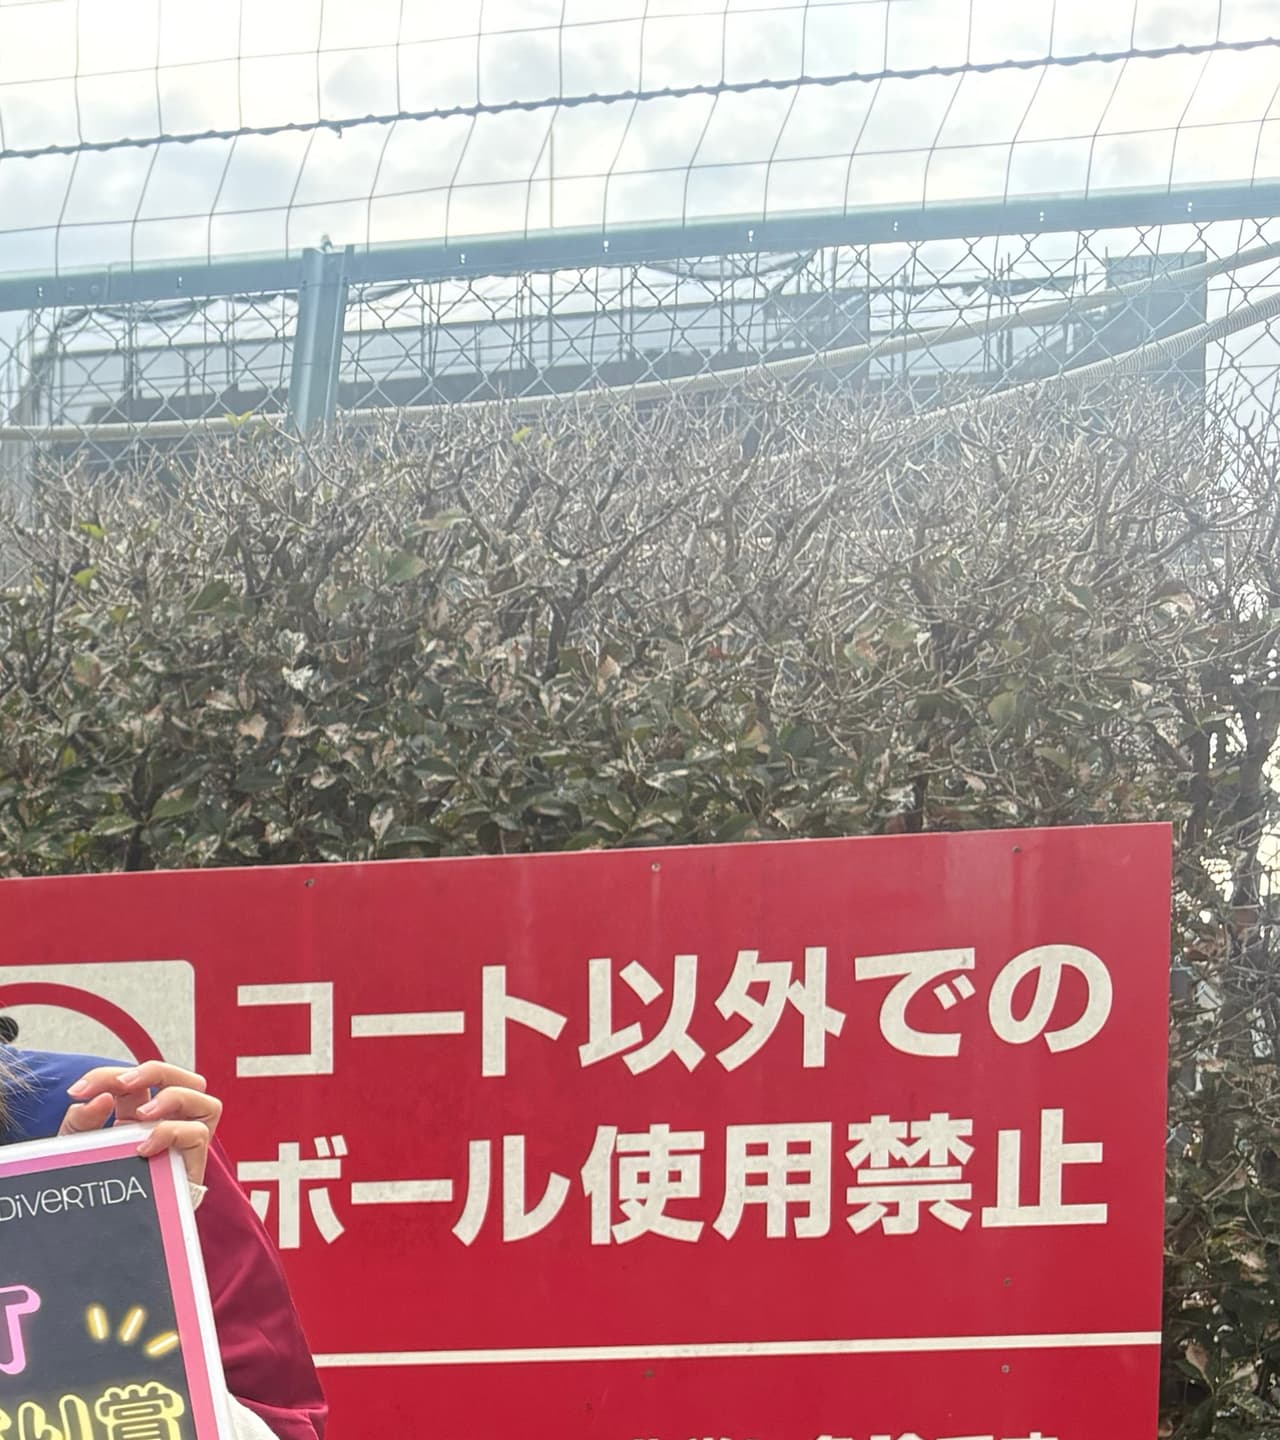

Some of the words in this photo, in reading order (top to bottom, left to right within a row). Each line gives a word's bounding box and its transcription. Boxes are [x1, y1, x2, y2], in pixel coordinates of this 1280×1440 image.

[237, 944, 1113, 1078] コート以外での
[237, 1108, 1108, 1249] ボール使用禁止
